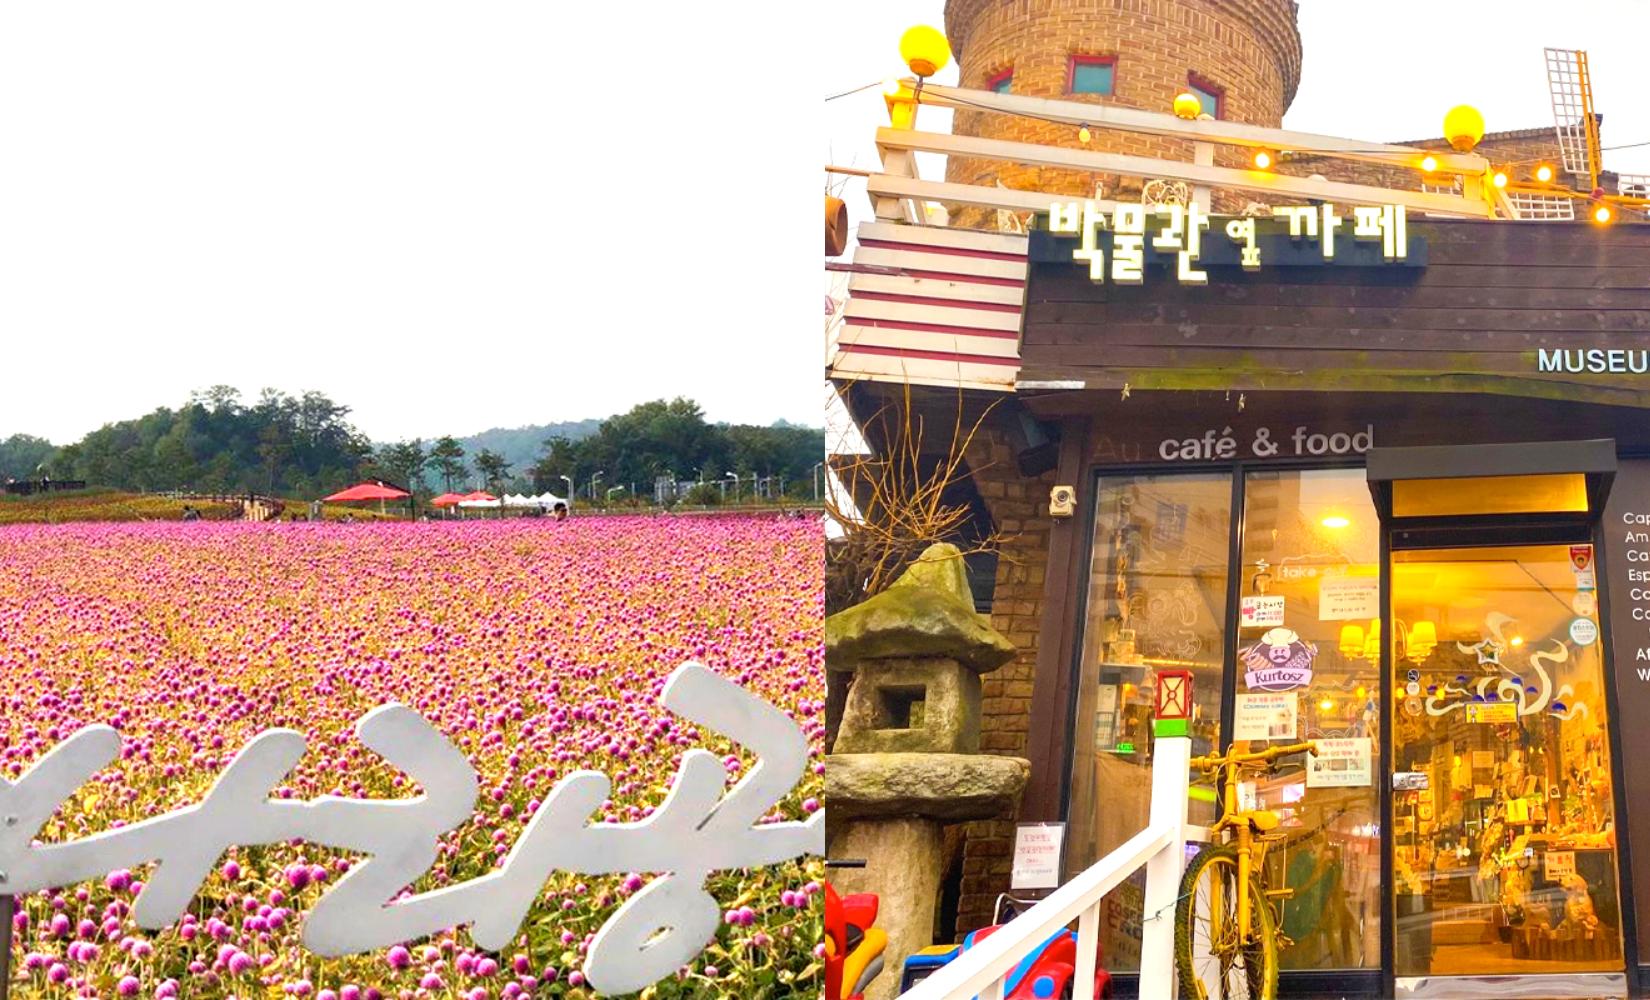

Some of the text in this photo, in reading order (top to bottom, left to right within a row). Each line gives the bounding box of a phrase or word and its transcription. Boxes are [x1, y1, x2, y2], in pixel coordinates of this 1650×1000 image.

[1049, 202, 1209, 285] 박물관
[1226, 217, 1261, 271] 옆
[1538, 348, 1648, 373] MUSEU
[1158, 424, 1375, 461] café & food
[1627, 549, 1650, 562] Ca
[1254, 670, 1304, 684] Kurtosz
